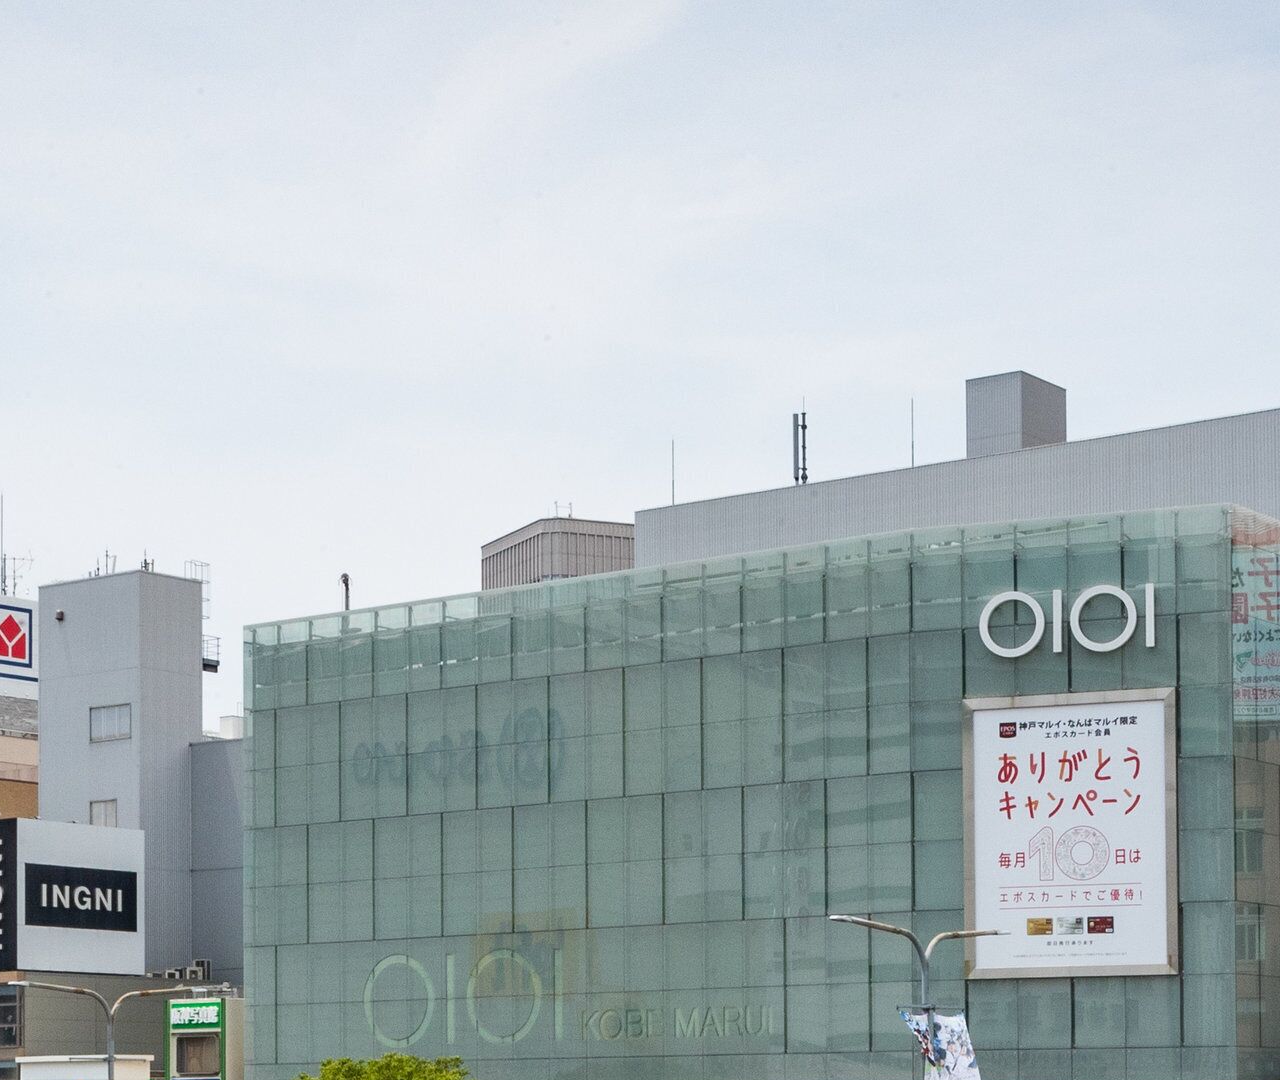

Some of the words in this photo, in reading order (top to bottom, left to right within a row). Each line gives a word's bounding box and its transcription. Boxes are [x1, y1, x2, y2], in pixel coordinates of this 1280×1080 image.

[978, 582, 1156, 658] OIOI
[1019, 715, 1138, 732] 神戸マルイ・なんばマルイ限定
[997, 746, 1141, 785] ありがとう
[999, 789, 1142, 821] キャンペーン
[41, 883, 124, 913] INGNI
[580, 1006, 667, 1041] KOBE
[674, 1004, 778, 1039] MARUI
